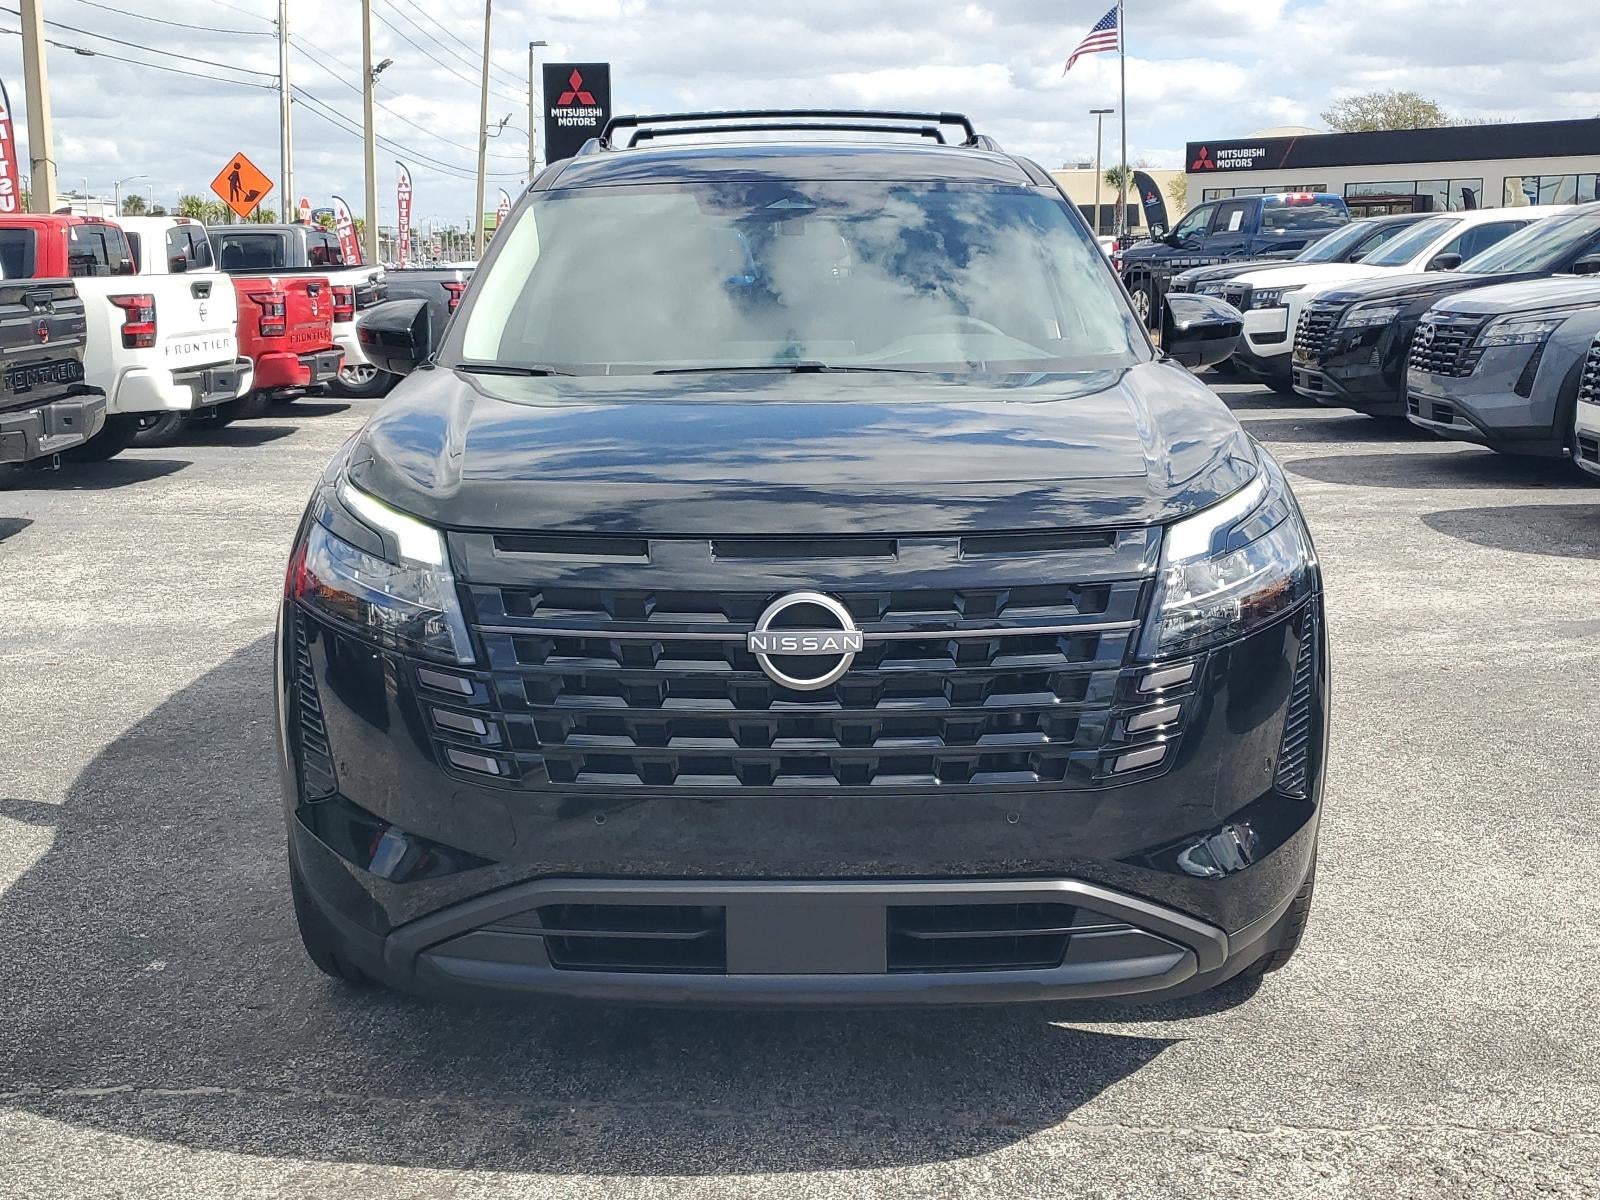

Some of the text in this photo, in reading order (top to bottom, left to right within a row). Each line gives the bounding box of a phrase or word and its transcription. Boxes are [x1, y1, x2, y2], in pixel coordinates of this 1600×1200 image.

[551, 108, 602, 117] MITSUBISHI
[558, 117, 596, 126] MOTORS
[1217, 147, 1266, 158] MITSUBISHI
[1217, 158, 1253, 168] MOTORS
[165, 338, 229, 356] FRONTIER
[751, 636, 860, 650] NISSAN
